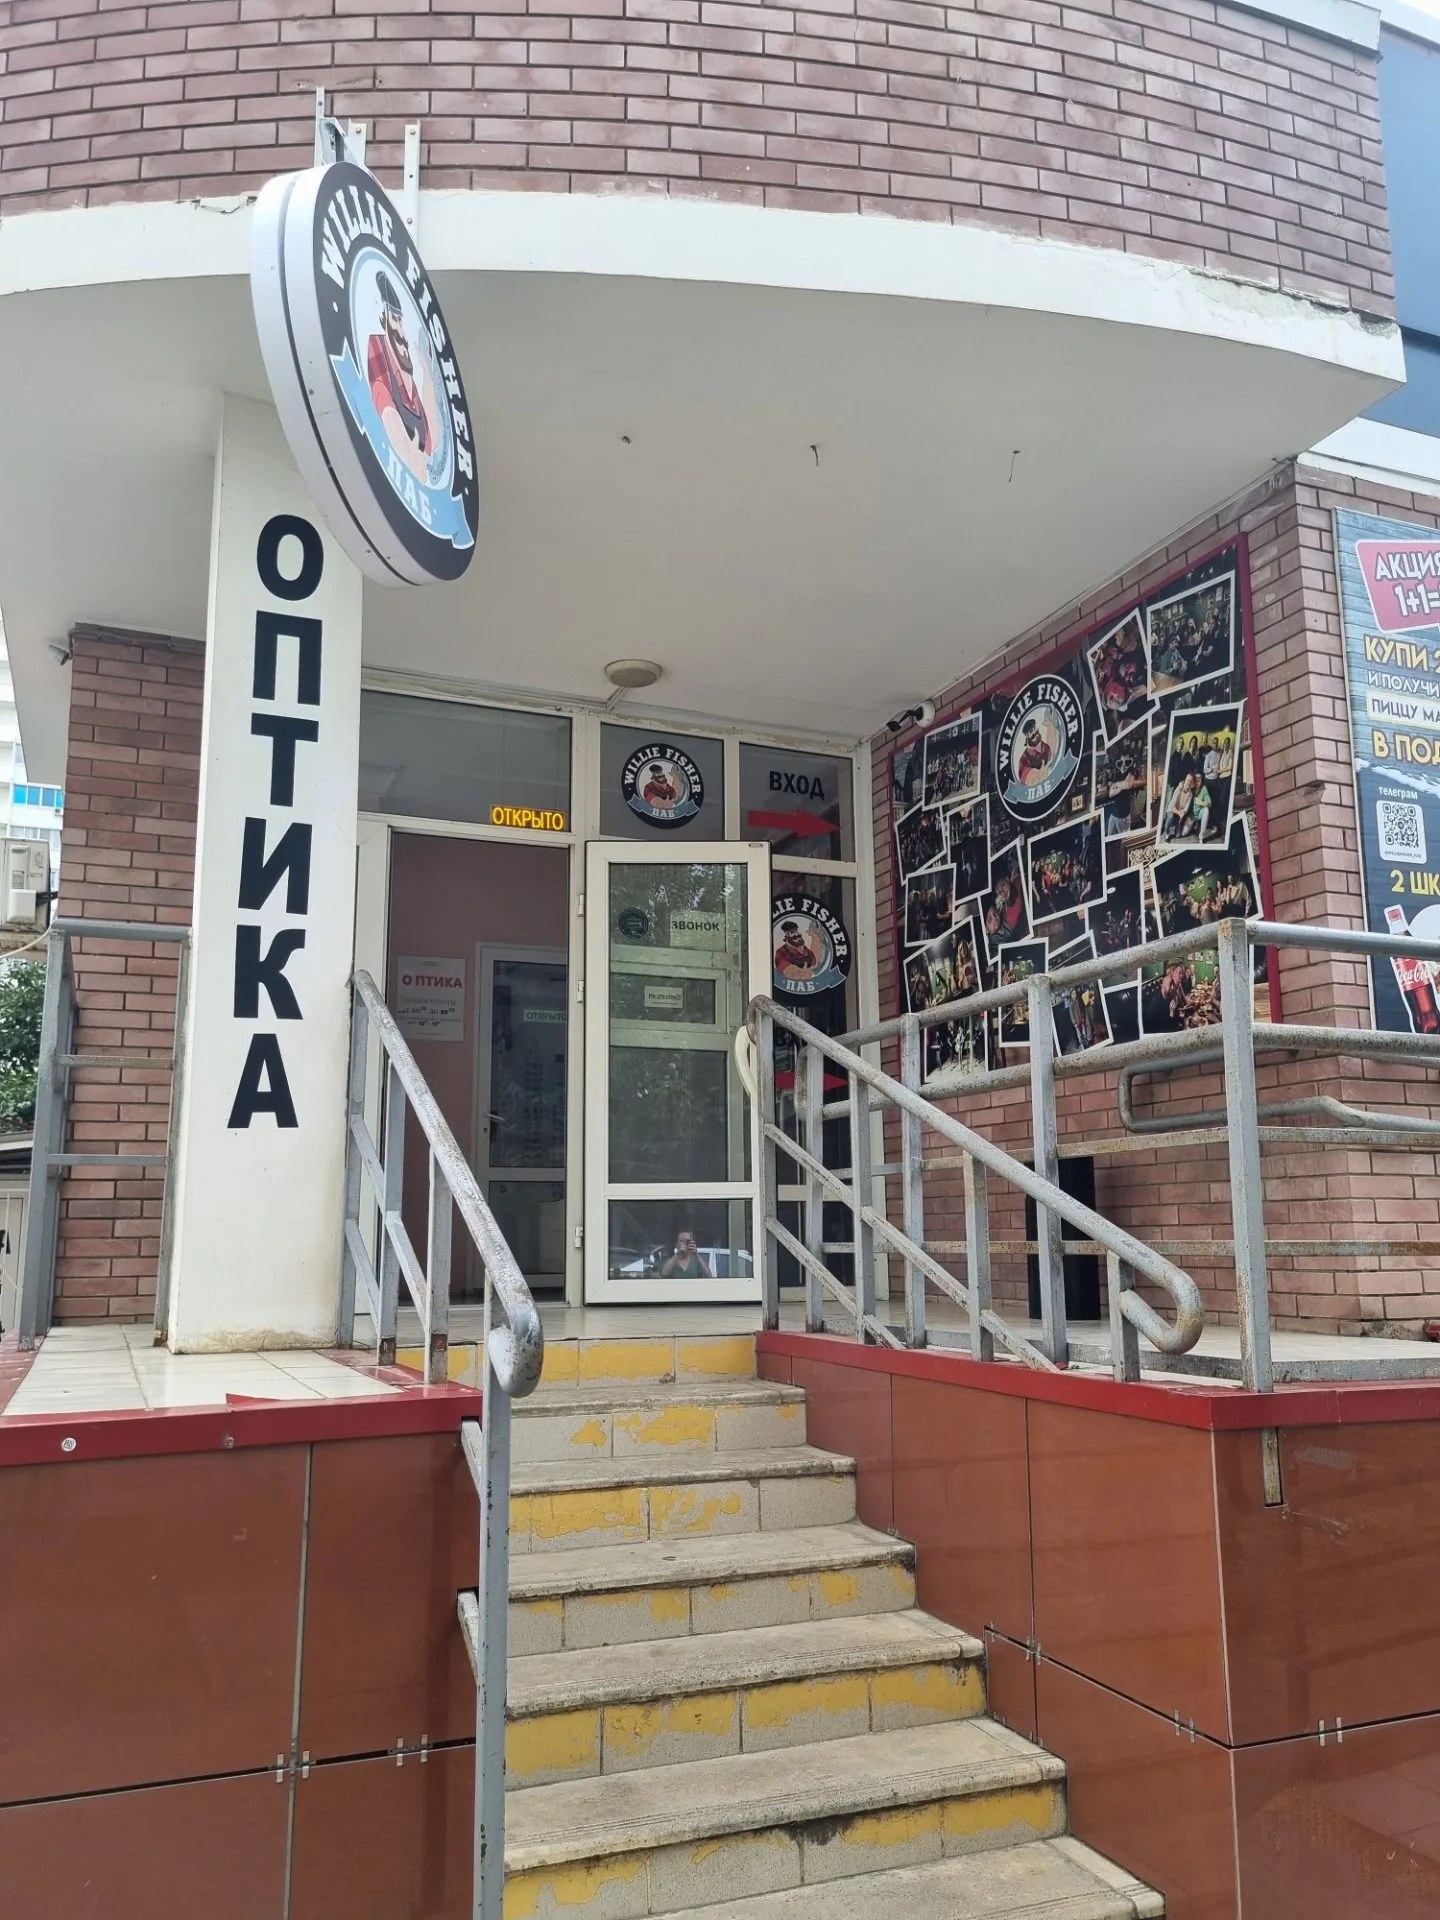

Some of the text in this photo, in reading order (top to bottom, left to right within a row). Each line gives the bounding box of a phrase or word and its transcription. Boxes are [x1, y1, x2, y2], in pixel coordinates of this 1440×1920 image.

[321, 185, 473, 481] WILLIE FISHER
[387, 447, 432, 525] ПАБ
[1394, 582, 1440, 617] 1+1=
[1364, 634, 1429, 673] КУПИ
[1372, 698, 1418, 721] ПИЦЦУ
[999, 683, 1078, 771] WILLIE FISHER
[1373, 729, 1389, 758] В
[624, 747, 702, 794] WILLIE FISHER
[768, 770, 825, 802] ВХОД
[227, 514, 324, 1129] ОПТИКА
[492, 806, 564, 831] ОТКРЫТО
[652, 807, 676, 818] ПАБ
[1390, 869, 1440, 897] 2 ШК
[671, 920, 720, 932] ЗВОНОК
[801, 898, 848, 957] FISHER
[786, 979, 816, 992] ПАБ
